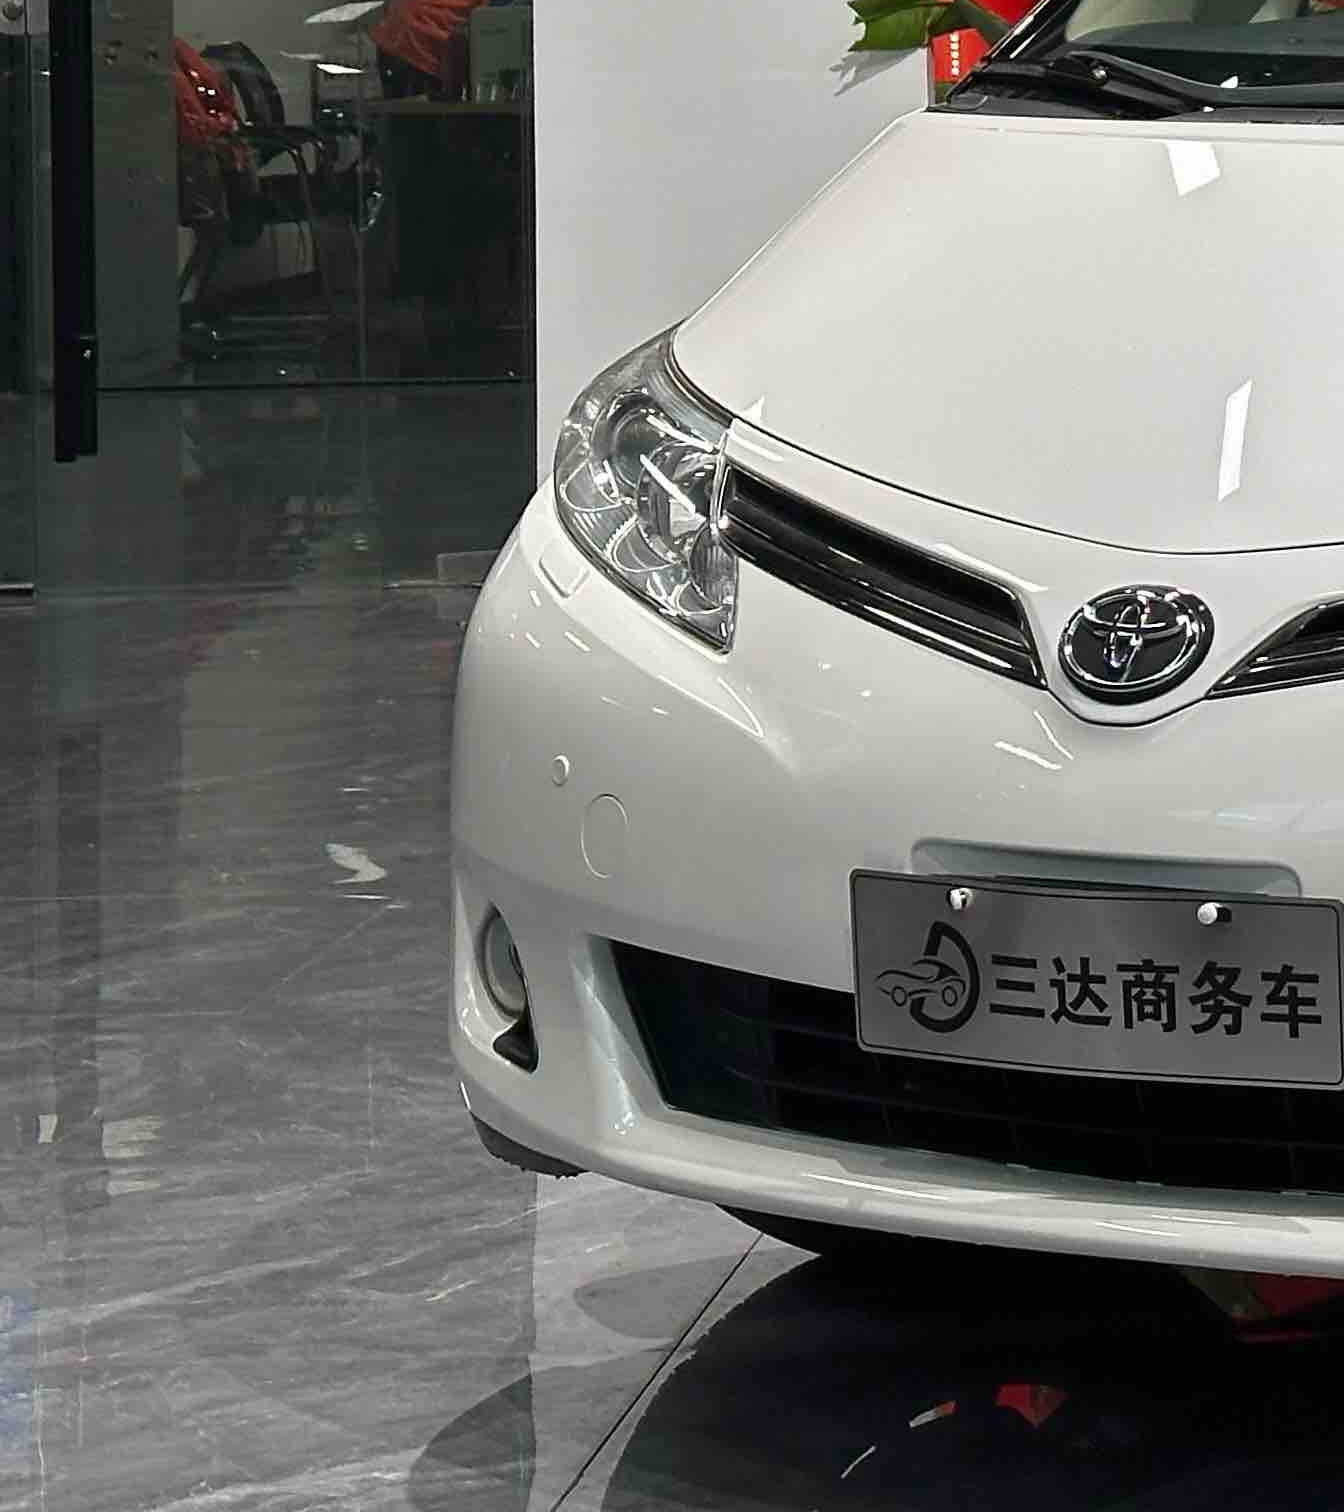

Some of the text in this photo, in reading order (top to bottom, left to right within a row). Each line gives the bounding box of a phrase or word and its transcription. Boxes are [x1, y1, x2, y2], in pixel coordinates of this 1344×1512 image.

[988, 953, 1323, 1039] 三达商务车
